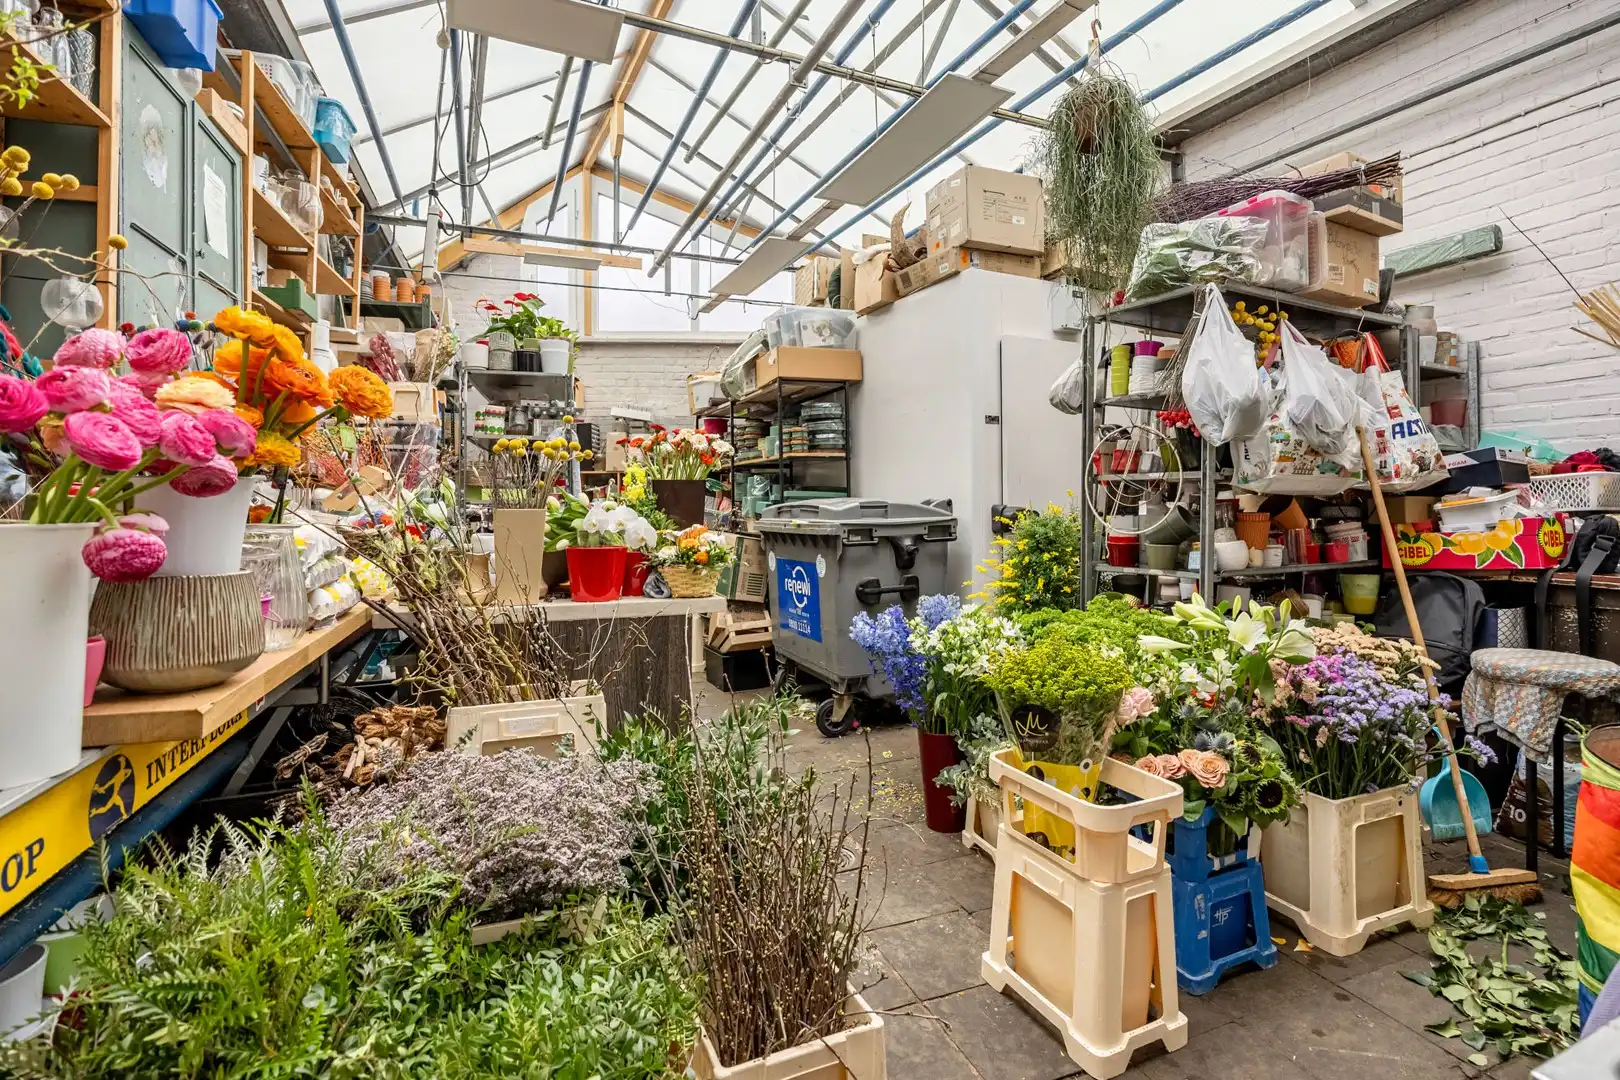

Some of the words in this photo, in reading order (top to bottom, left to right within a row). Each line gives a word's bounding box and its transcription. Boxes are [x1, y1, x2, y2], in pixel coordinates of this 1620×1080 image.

[1544, 529, 1564, 546] CIBEL
[1398, 545, 1431, 559] CIBEL
[785, 578, 811, 596] renewi
